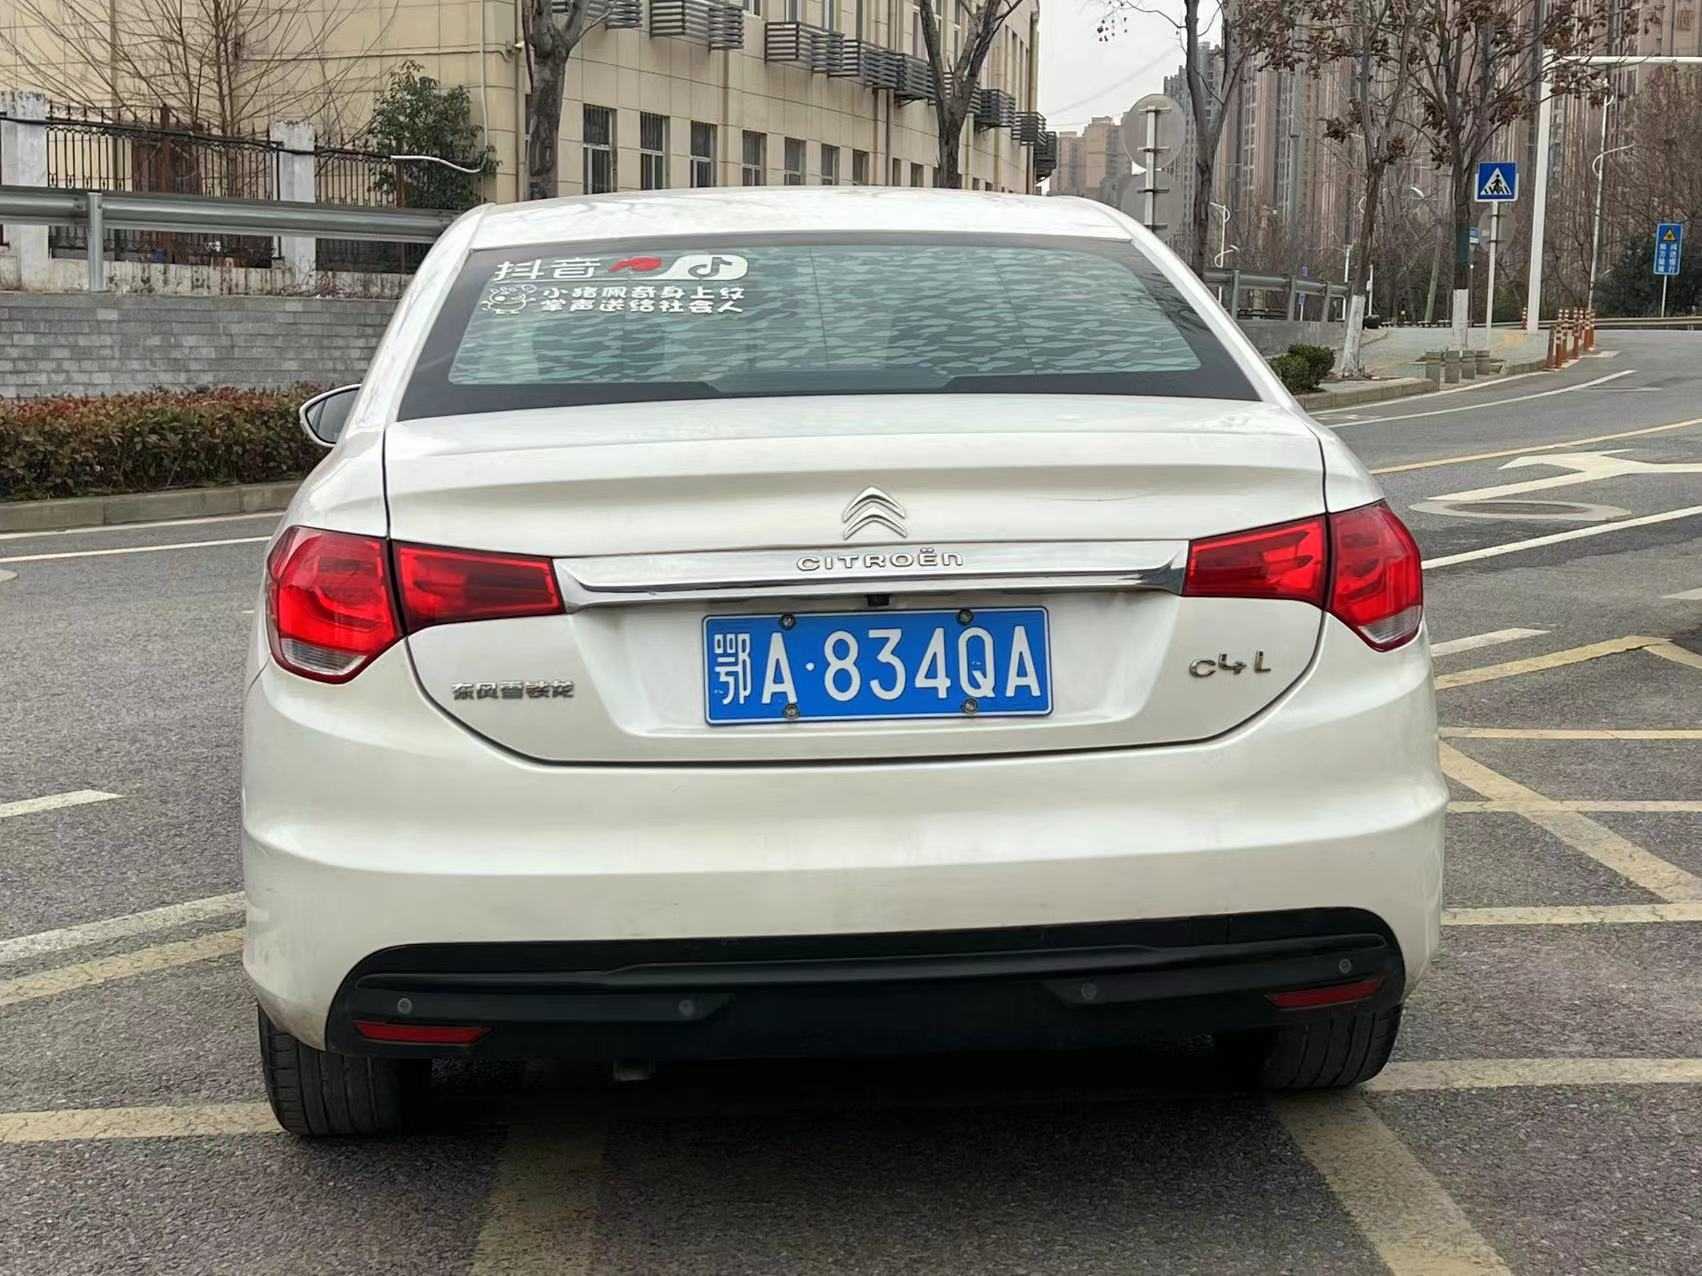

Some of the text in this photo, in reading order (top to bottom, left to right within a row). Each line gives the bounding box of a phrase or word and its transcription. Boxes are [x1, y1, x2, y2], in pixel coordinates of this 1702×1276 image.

[493, 256, 601, 281] 抖音
[452, 680, 574, 701] 东风雪铁龙
